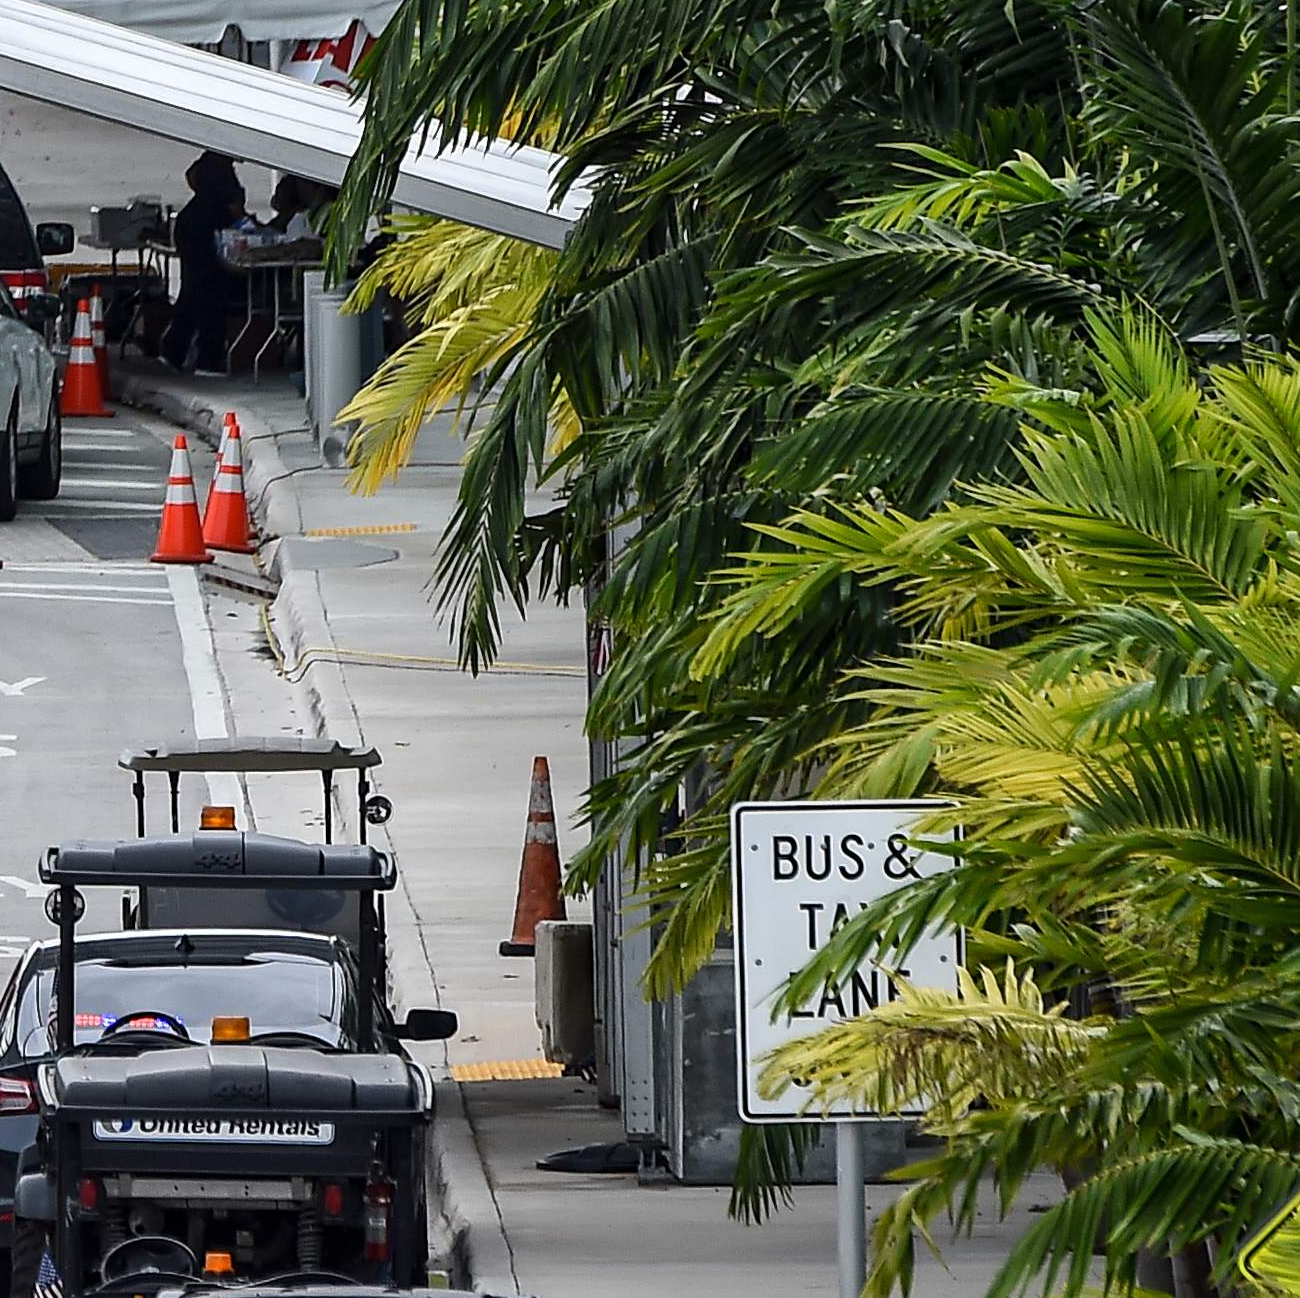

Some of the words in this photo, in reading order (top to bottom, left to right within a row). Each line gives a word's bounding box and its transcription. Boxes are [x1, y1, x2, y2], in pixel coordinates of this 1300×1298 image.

[773, 834, 864, 880] BUS
[883, 833, 924, 879] &
[139, 1118, 220, 1135] United
[229, 1119, 320, 1137] Rentals
